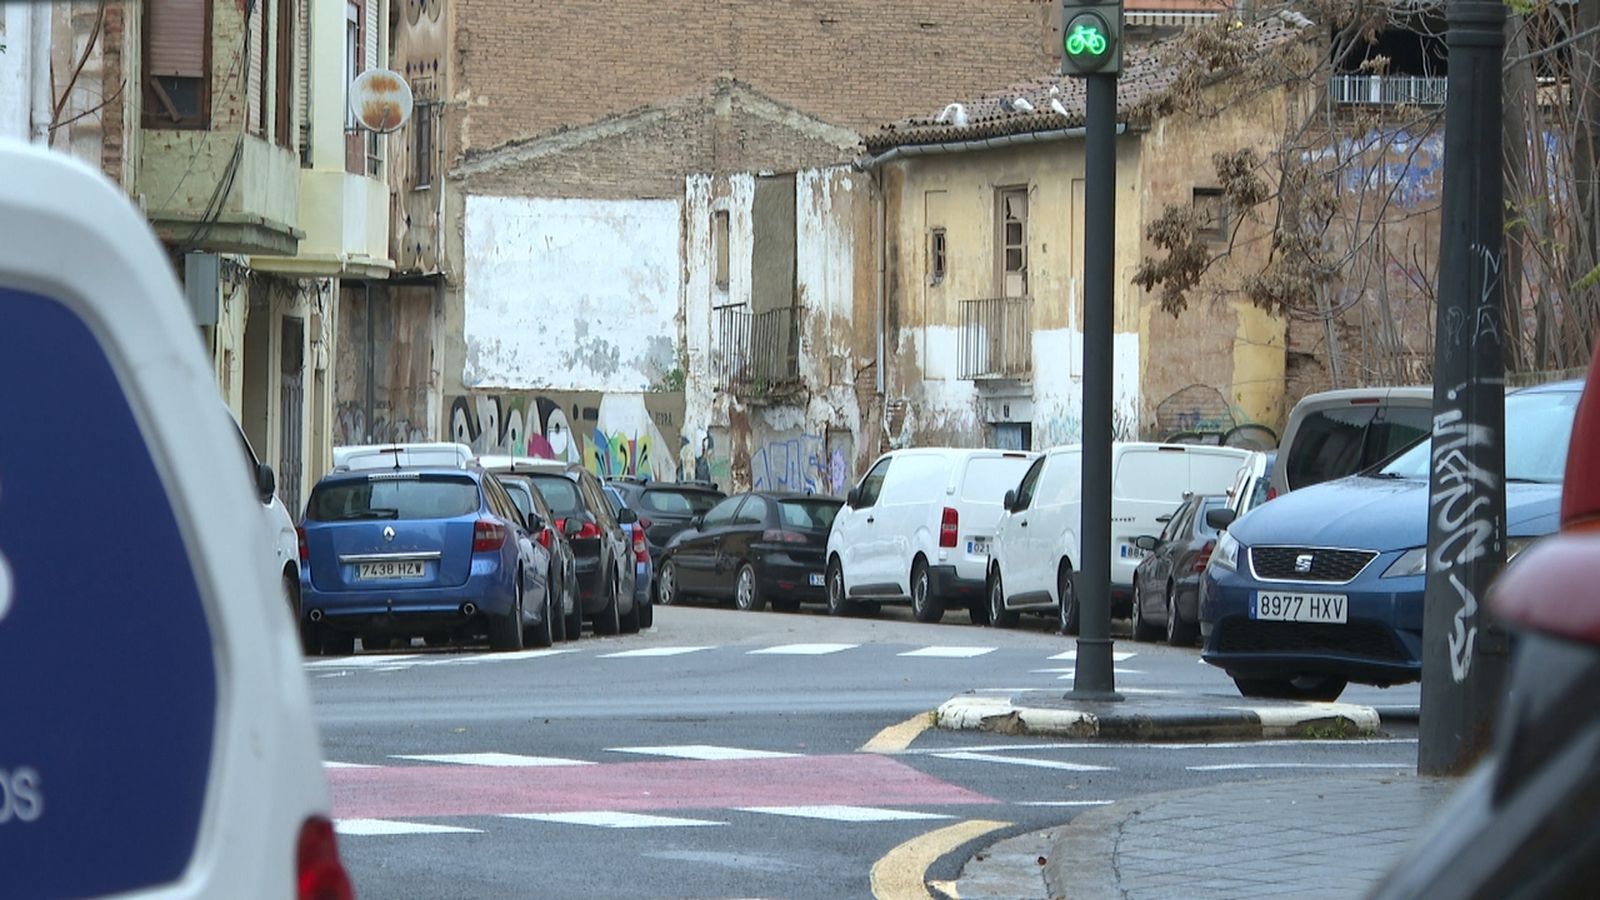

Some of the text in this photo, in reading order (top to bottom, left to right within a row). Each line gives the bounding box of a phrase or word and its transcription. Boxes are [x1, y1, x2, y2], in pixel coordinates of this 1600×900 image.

[362, 561, 422, 576] 7438 HZW
[1261, 594, 1343, 619] 8977 HXV
